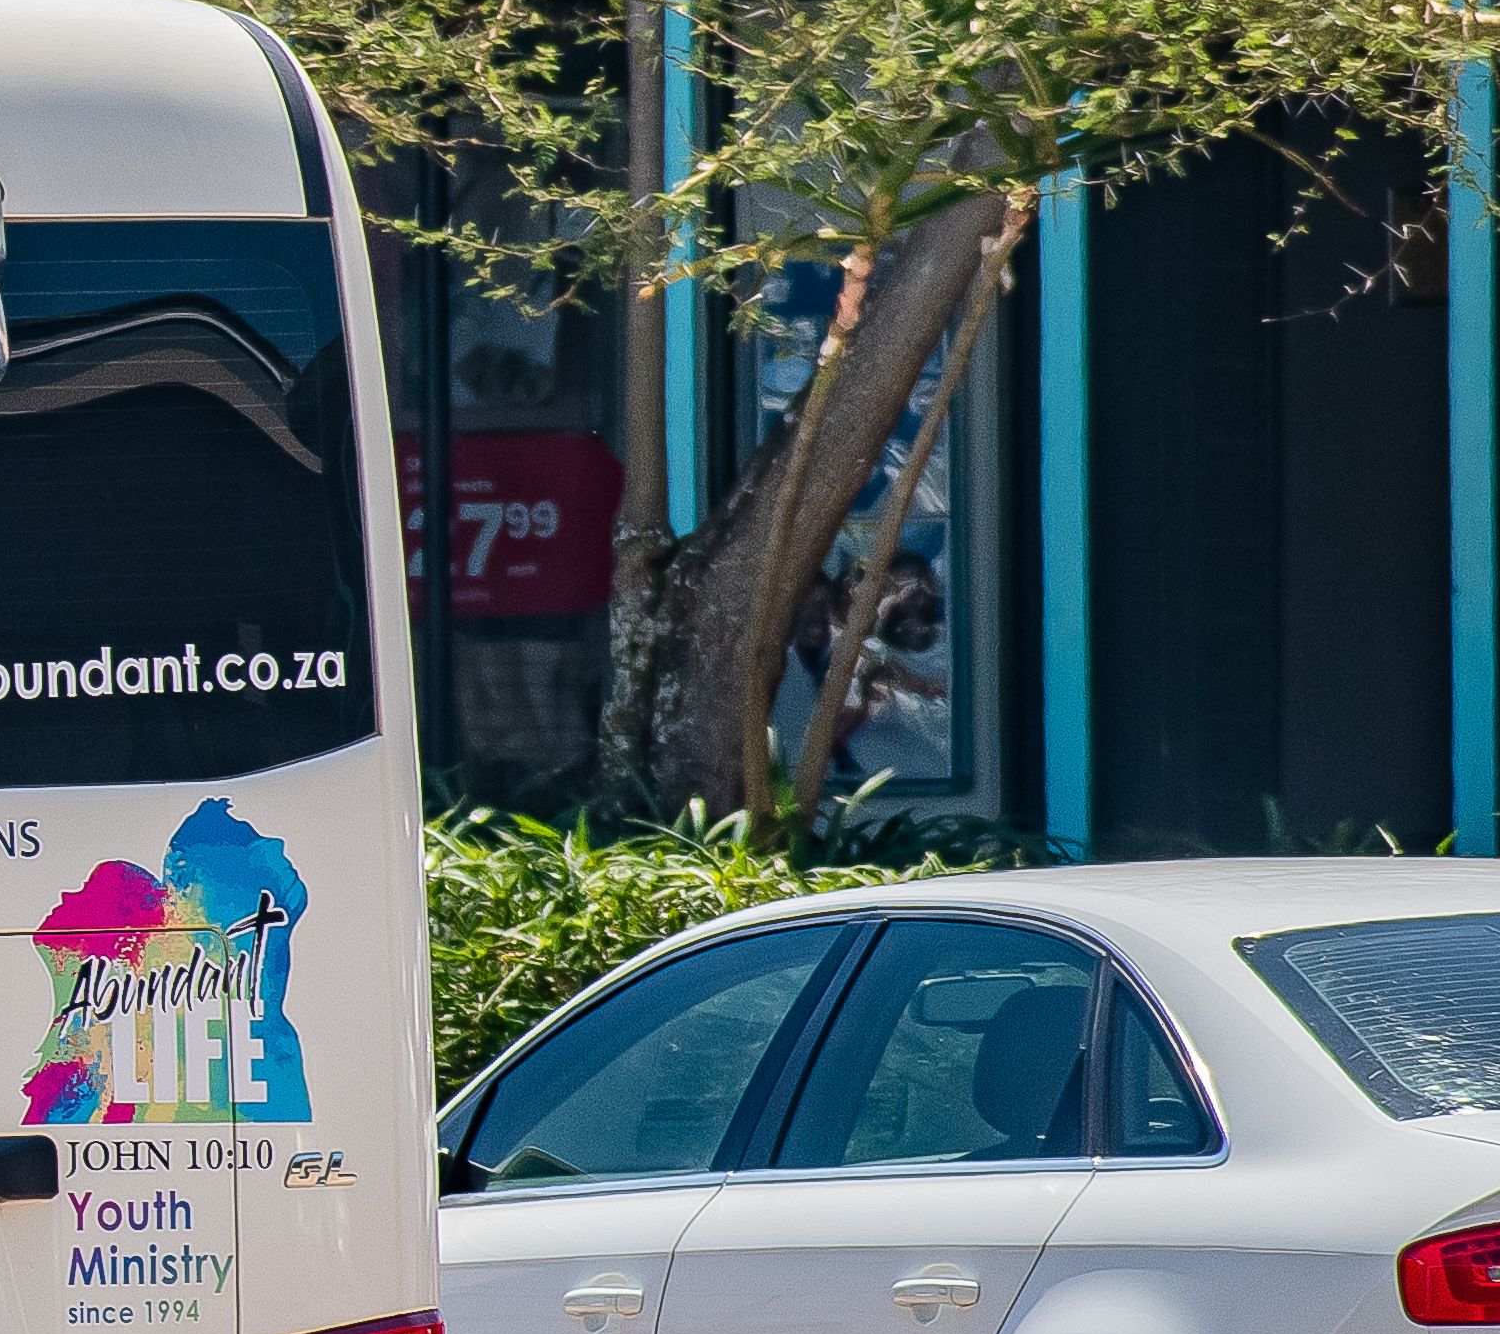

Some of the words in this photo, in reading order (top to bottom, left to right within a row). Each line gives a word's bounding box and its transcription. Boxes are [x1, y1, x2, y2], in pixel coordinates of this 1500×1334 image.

[60, 890, 288, 1038] Abundant
[111, 999, 269, 1105] LIFE
[66, 1140, 172, 1178] JOHN
[185, 1140, 273, 1171] 10:10
[67, 1191, 192, 1232] Youth
[67, 1245, 234, 1293] Ministry
[68, 1302, 134, 1324] since
[145, 1300, 200, 1323] 1994
